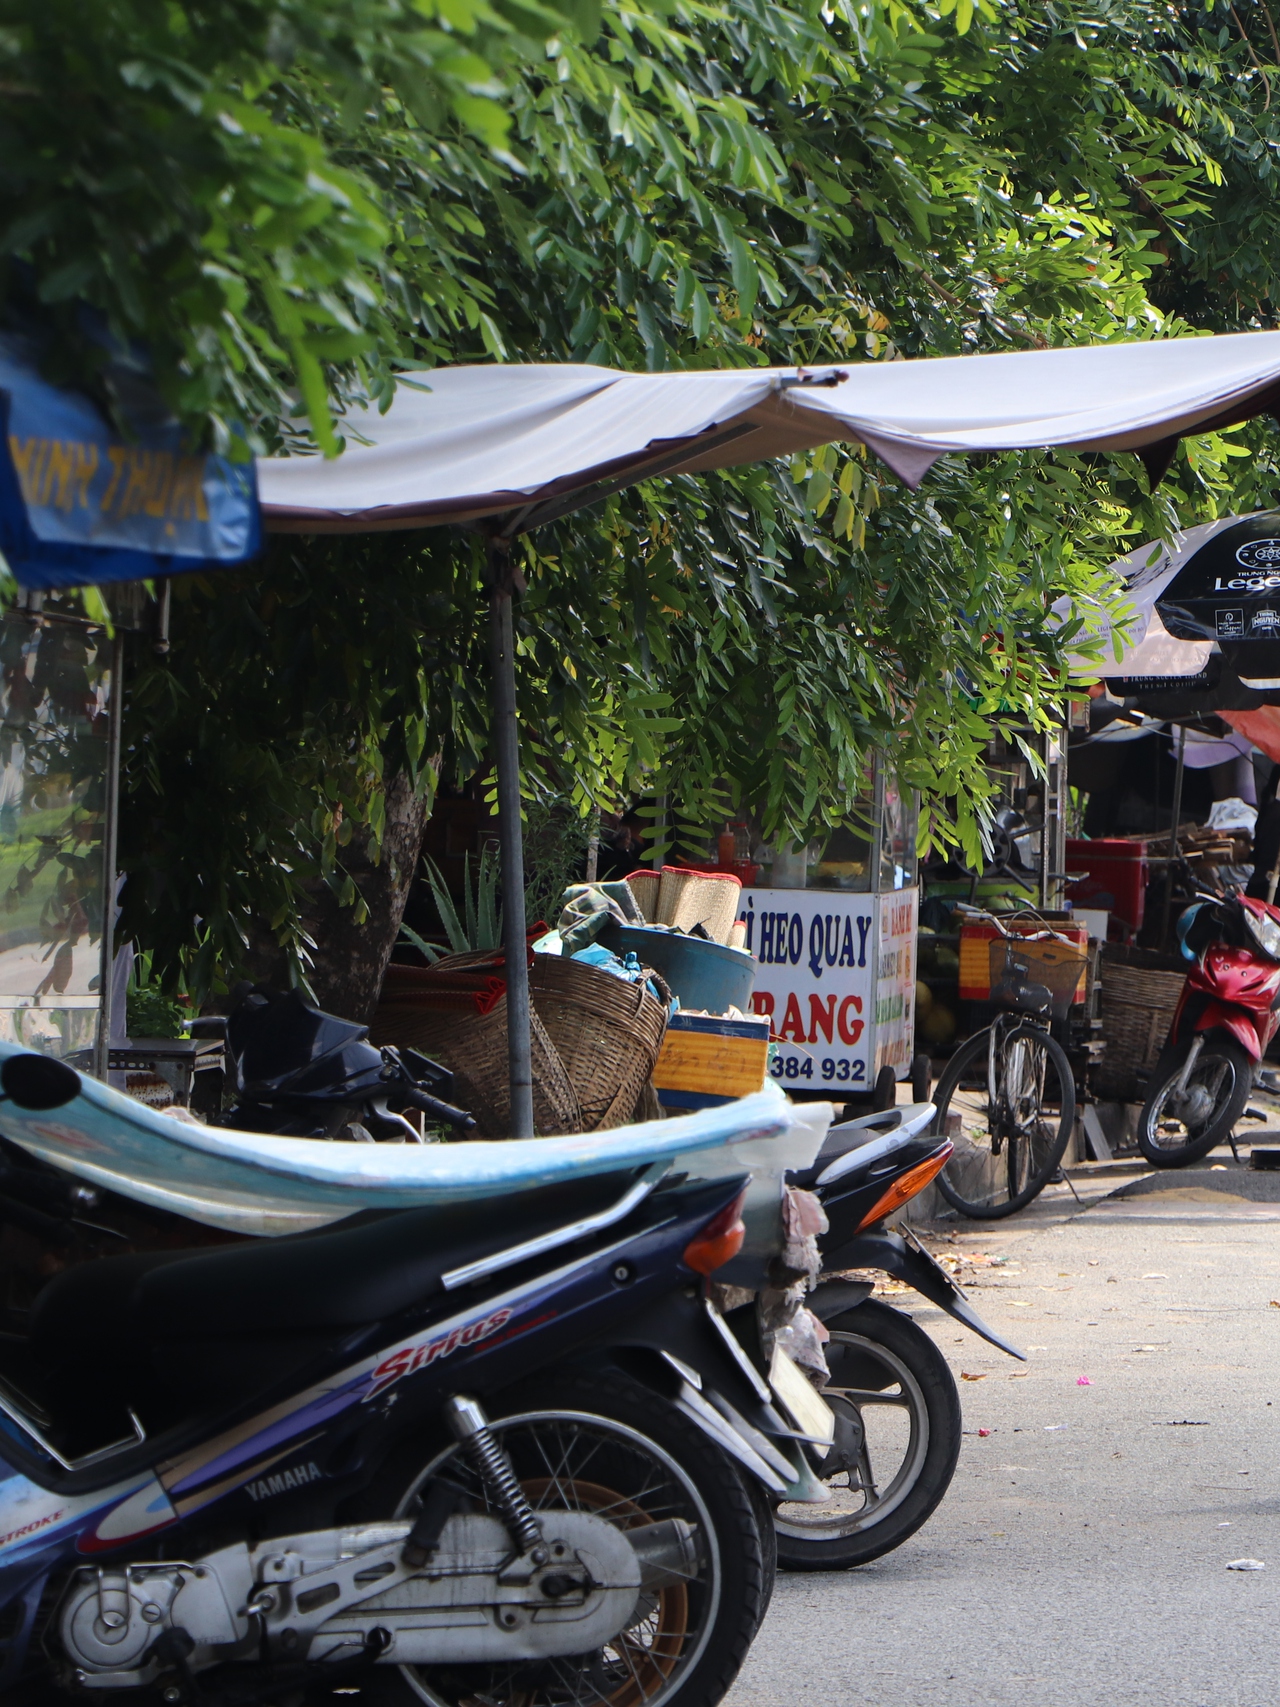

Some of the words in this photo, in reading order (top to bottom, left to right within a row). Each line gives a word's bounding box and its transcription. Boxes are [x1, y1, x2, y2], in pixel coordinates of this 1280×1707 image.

[738, 895, 755, 951] Ì
[759, 912, 803, 965] HEO
[808, 913, 872, 979] QUAY
[749, 991, 865, 1045] RANG
[770, 1056, 814, 1080] 384
[821, 1058, 865, 1081] 932
[361, 1308, 513, 1403] Sirius
[244, 1461, 322, 1501] YAMAHA
[0, 1509, 65, 1546] STROKE
